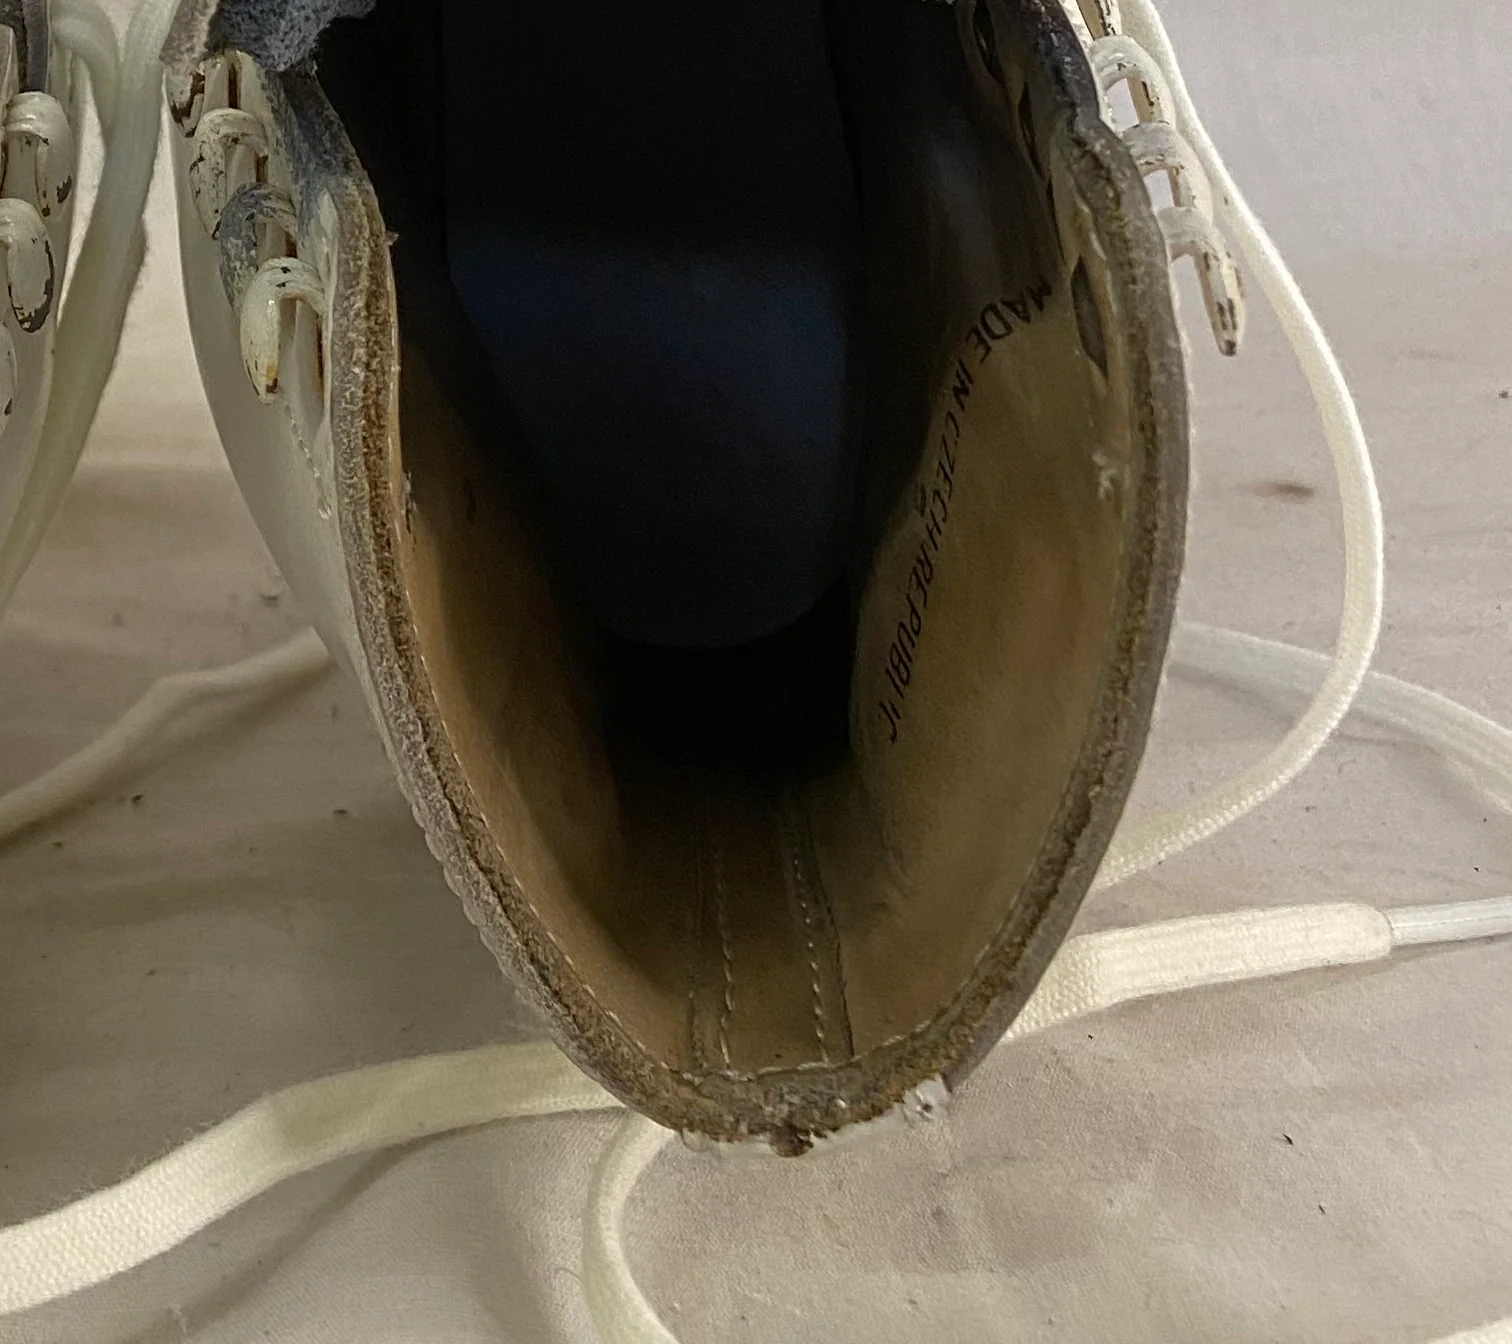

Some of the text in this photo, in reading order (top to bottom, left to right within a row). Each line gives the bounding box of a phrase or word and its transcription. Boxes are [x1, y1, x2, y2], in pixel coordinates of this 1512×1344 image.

[965, 276, 1054, 363] MADE
[951, 358, 975, 412] IN
[925, 411, 961, 550] CZECH
